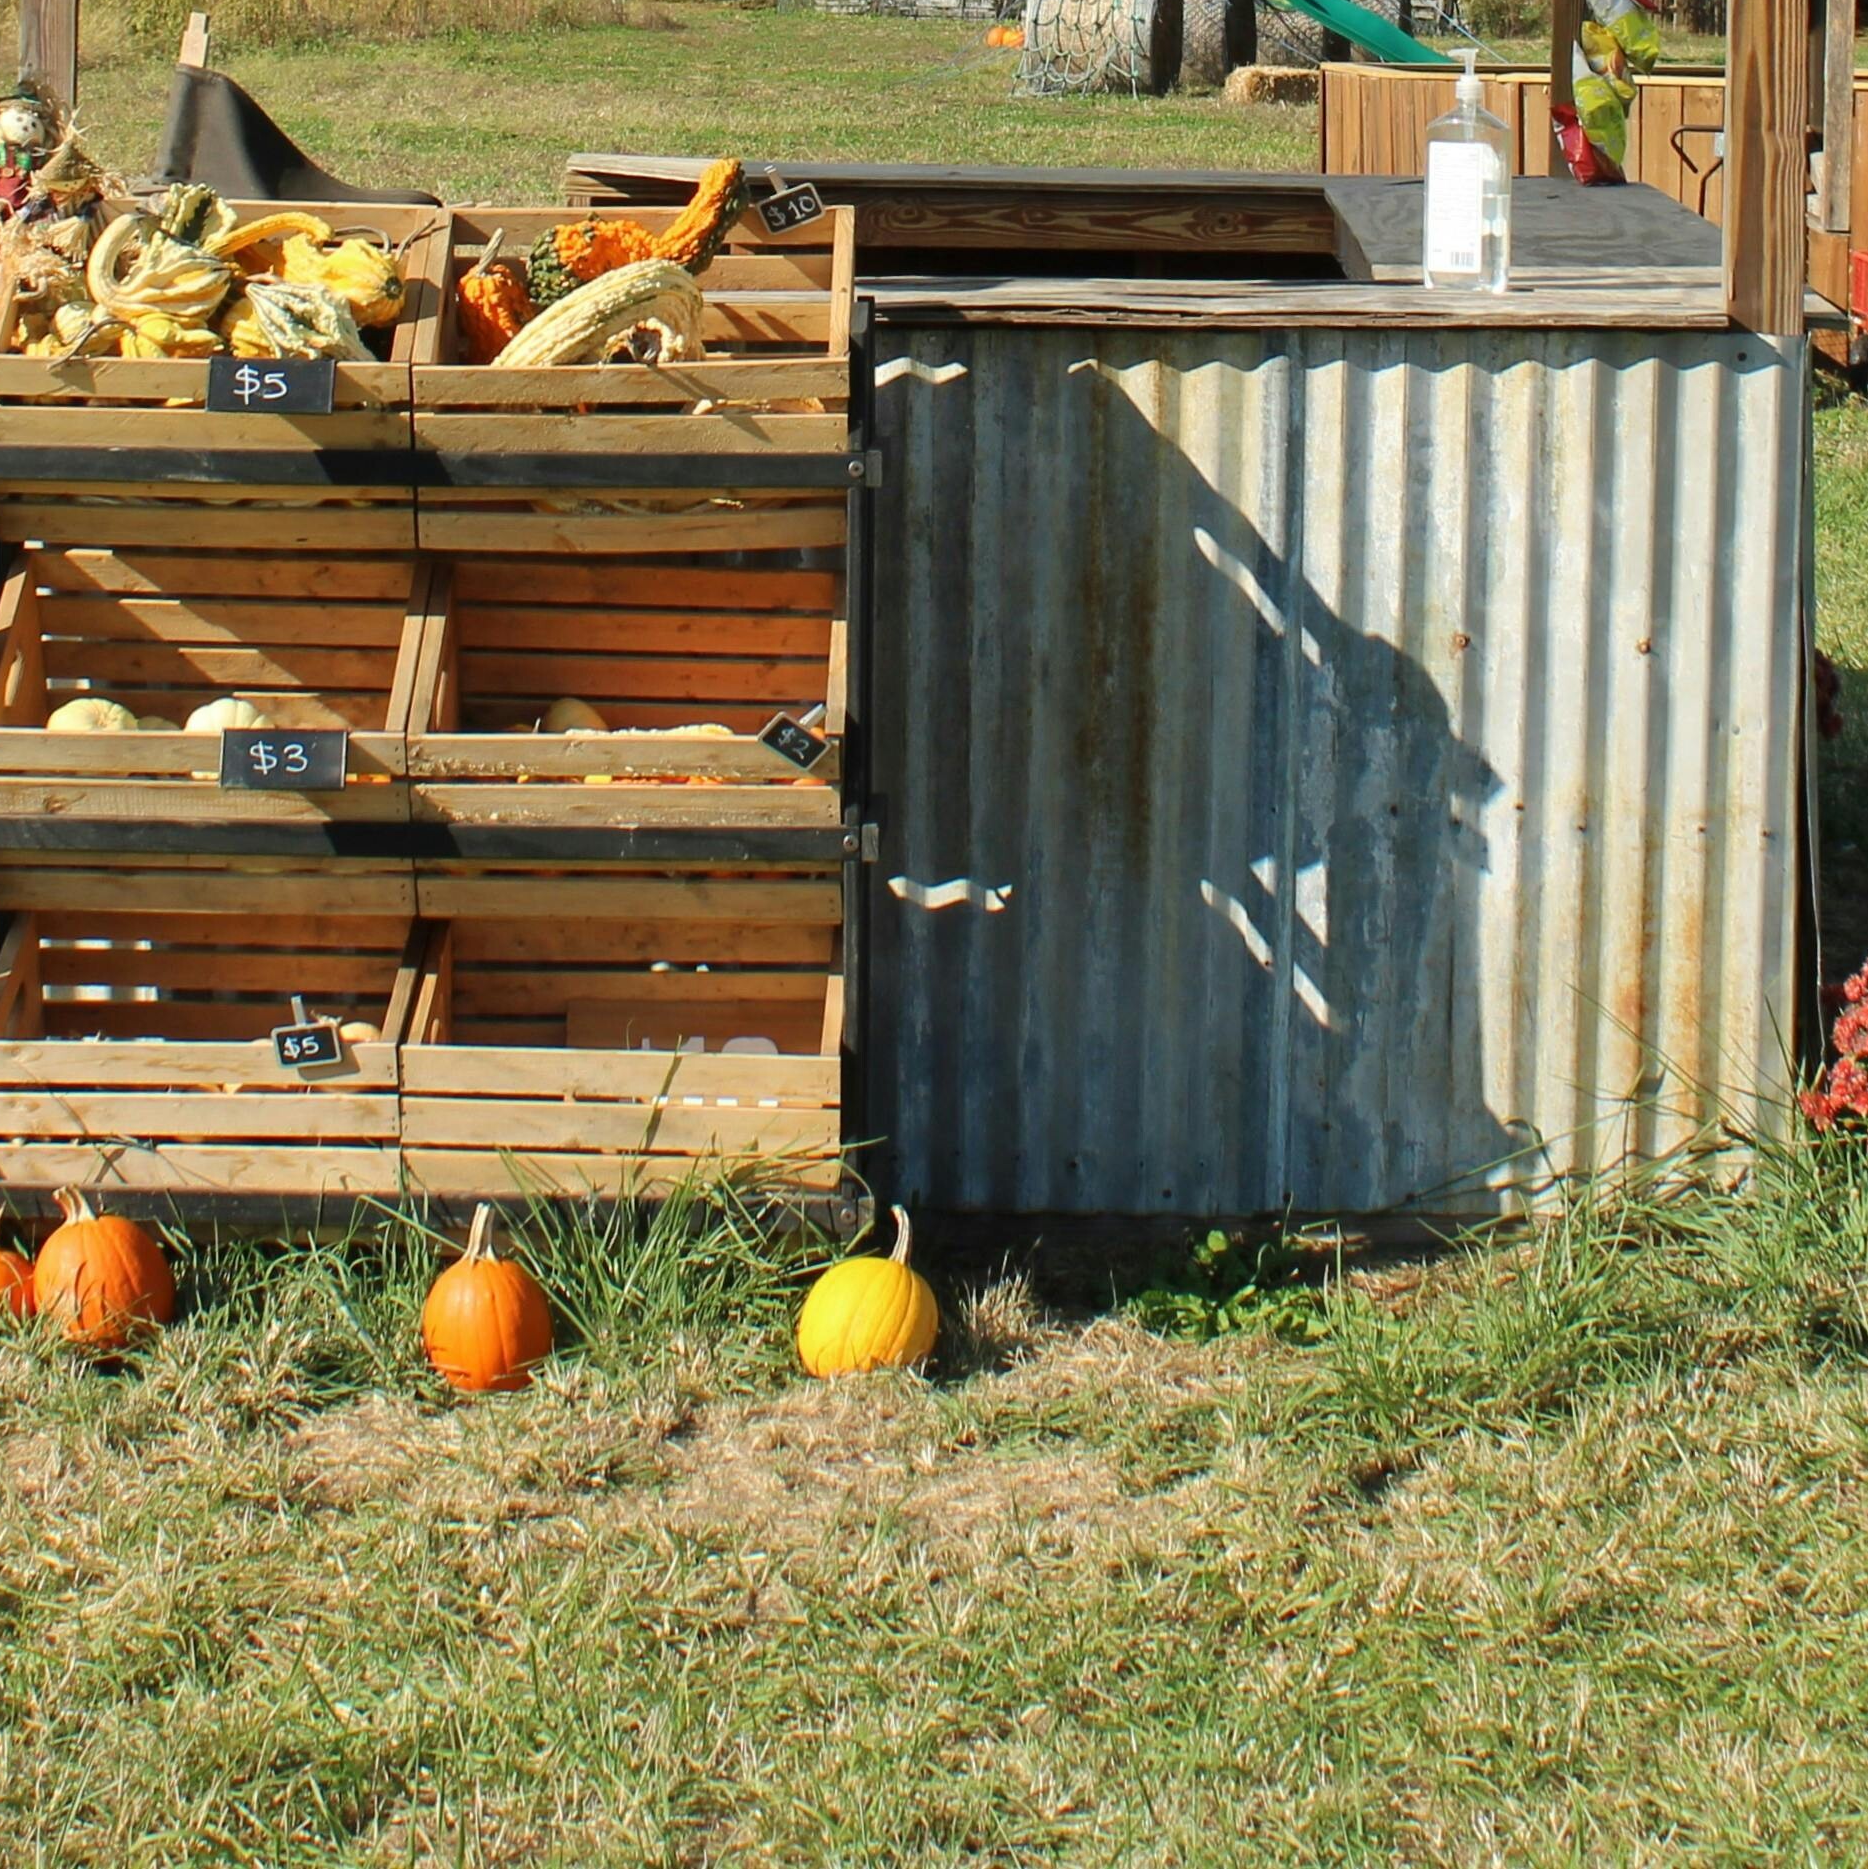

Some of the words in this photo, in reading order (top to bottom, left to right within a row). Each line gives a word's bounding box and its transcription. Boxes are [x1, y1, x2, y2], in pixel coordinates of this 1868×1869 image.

[766, 195, 816, 227] $10
[232, 363, 289, 406] $5
[249, 740, 309, 775] $3
[777, 726, 811, 760] $2
[282, 1035, 320, 1060] $5
